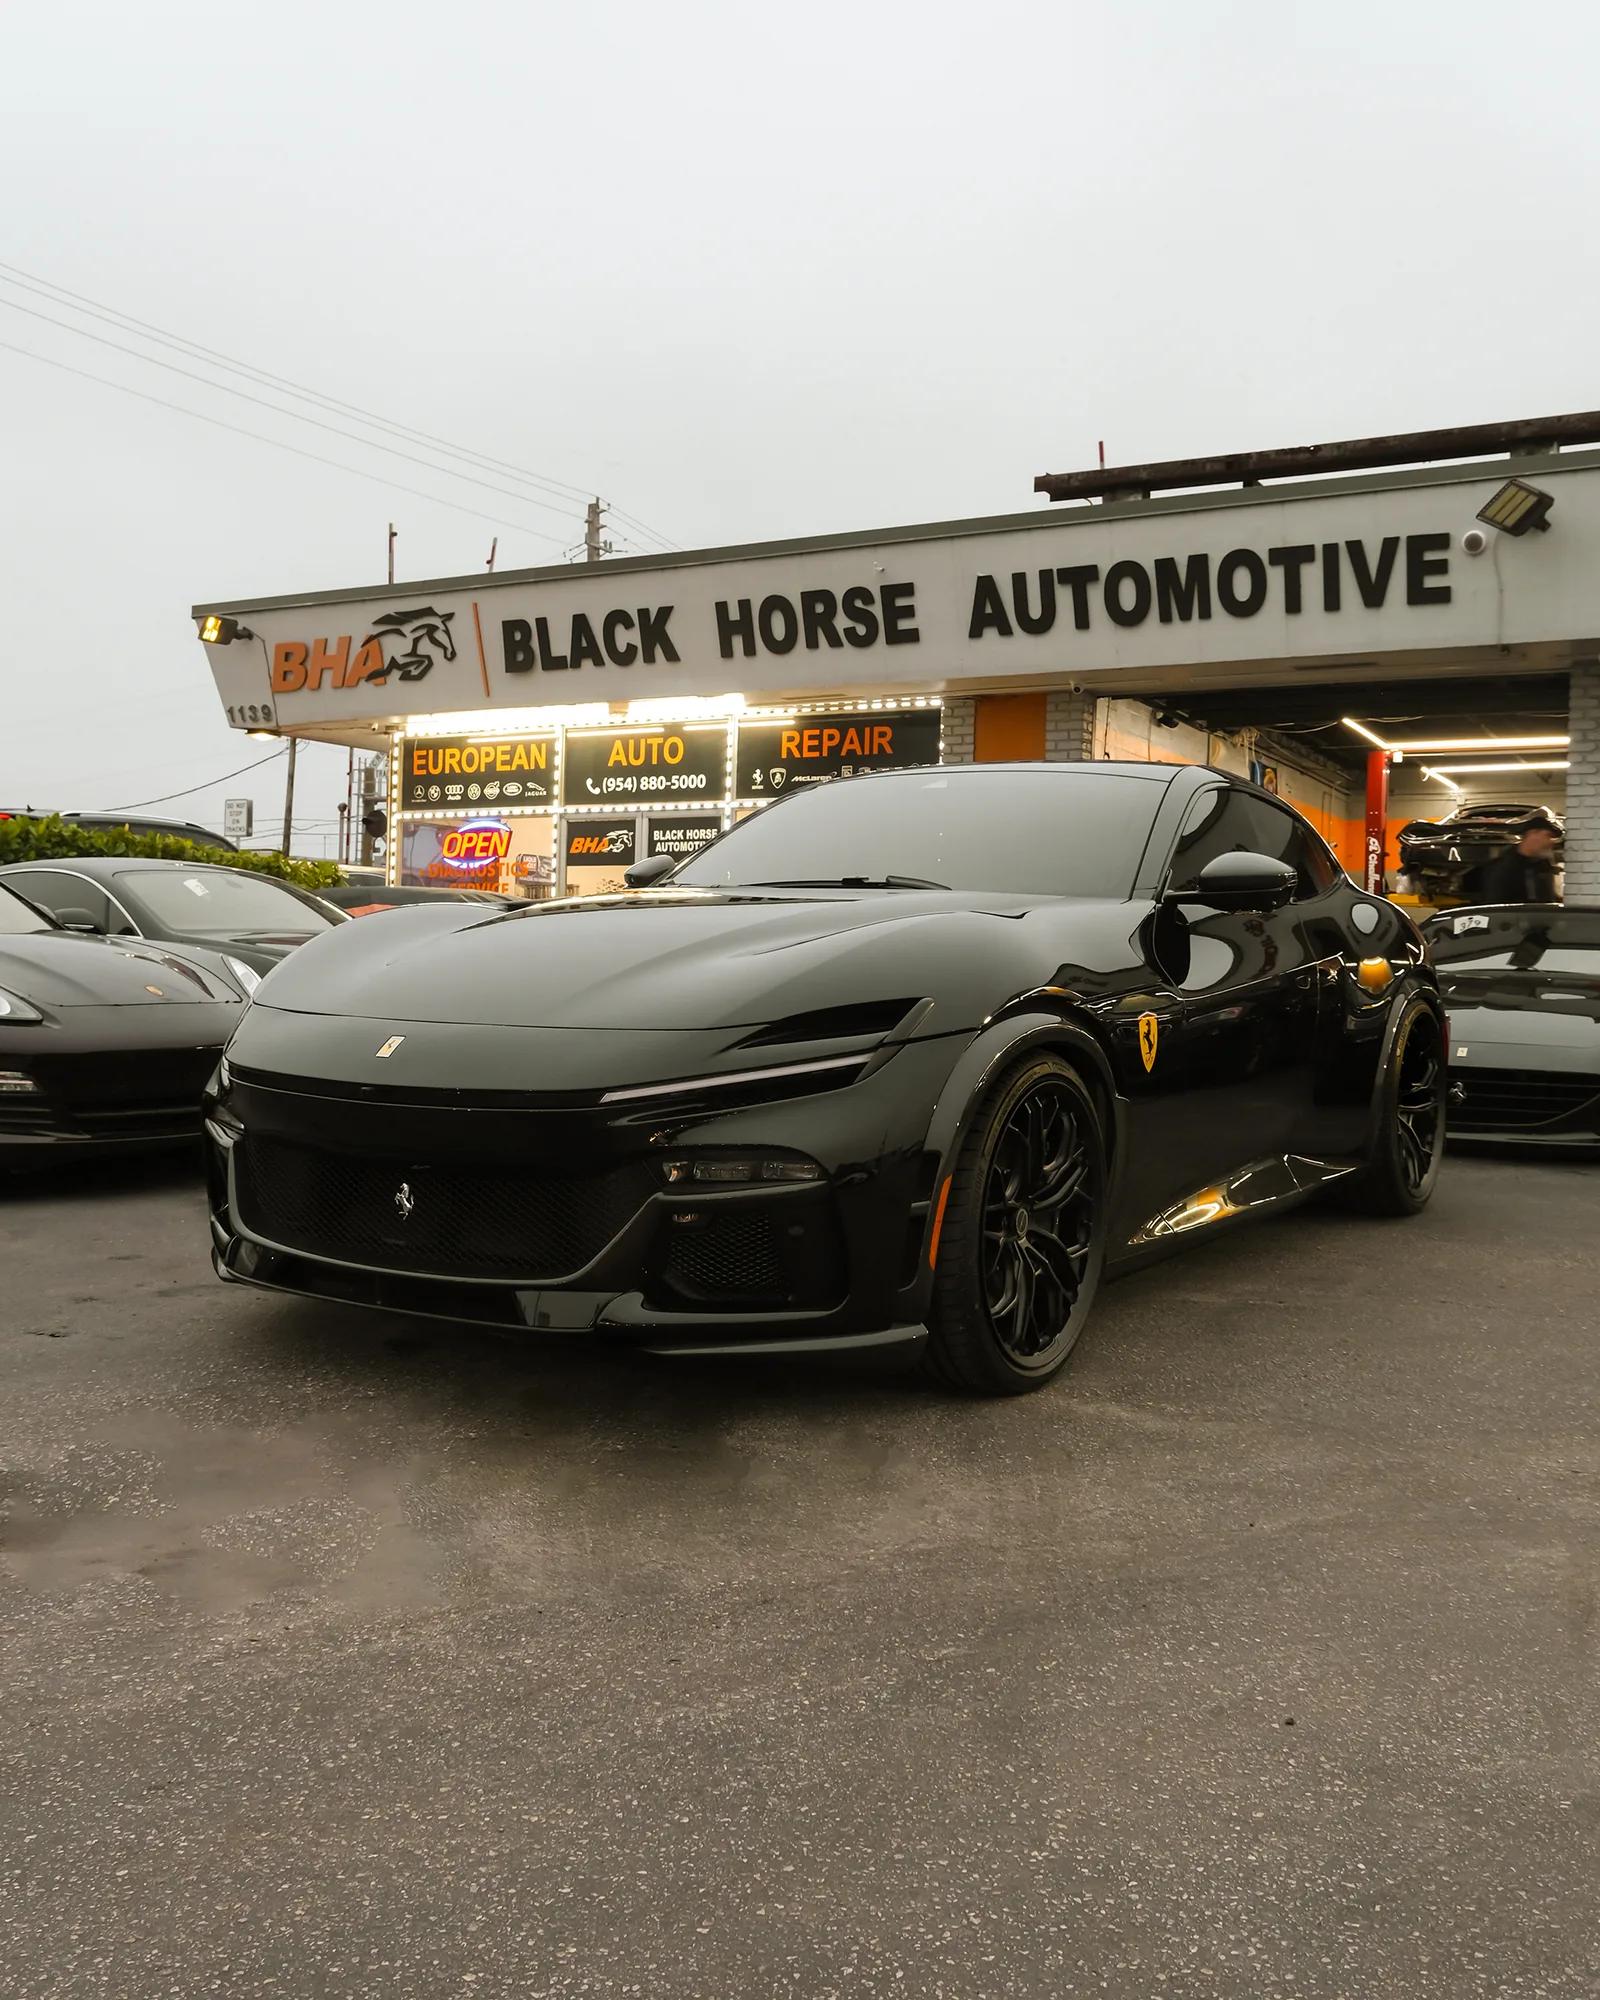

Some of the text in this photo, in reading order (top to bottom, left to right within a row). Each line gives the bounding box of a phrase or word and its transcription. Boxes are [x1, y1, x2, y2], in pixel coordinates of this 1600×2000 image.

[501, 532, 1452, 674] BLACK HORSE AUTOMOTIVE
[271, 634, 386, 693] BHA
[227, 704, 272, 722] 1139
[608, 736, 684, 767] AUTO
[781, 726, 894, 759] REPAIR
[413, 743, 546, 775] EUROPEAN
[602, 774, 706, 794] (954) 880-5000
[442, 831, 509, 857] OPEN
[569, 837, 610, 854] BHA
[653, 828, 718, 841] BLACK HORSE
[655, 840, 706, 852] AUTOMOTI
[428, 861, 528, 878] DIAGNOSTICS
